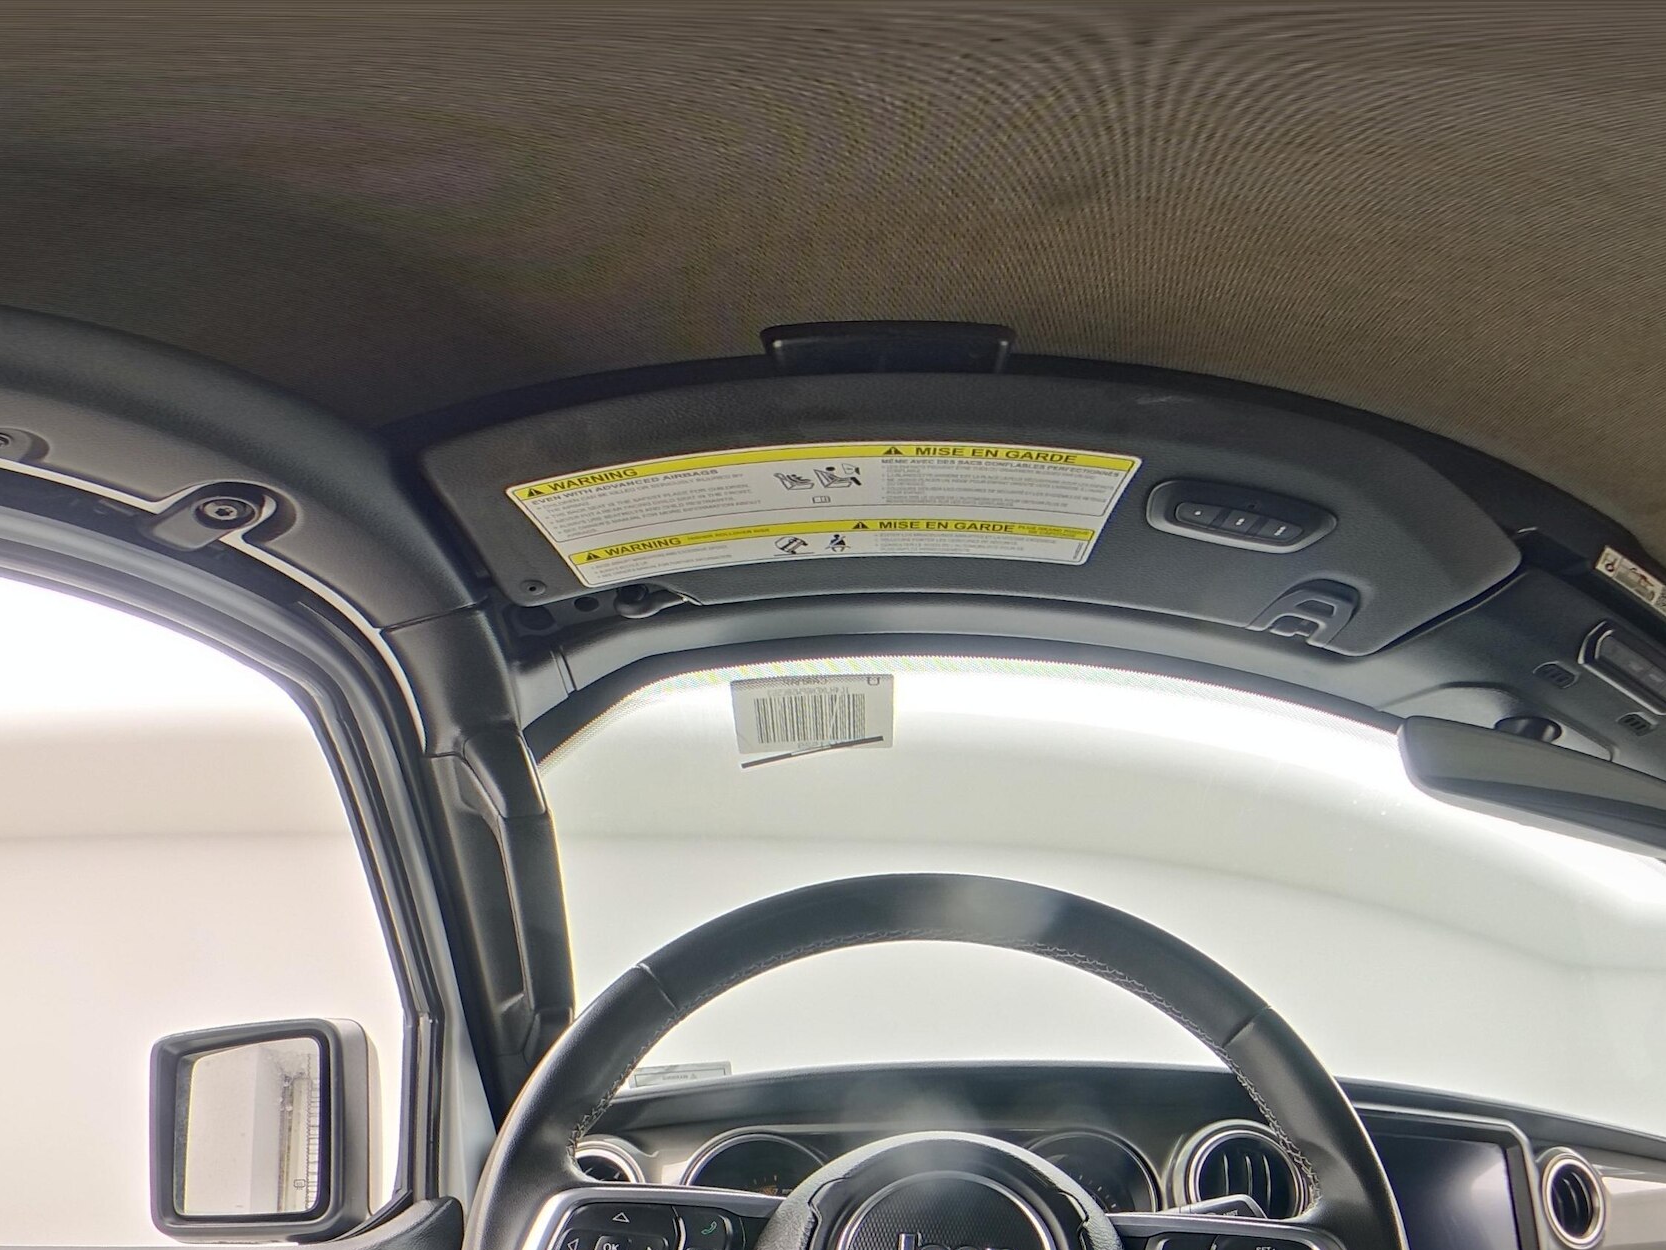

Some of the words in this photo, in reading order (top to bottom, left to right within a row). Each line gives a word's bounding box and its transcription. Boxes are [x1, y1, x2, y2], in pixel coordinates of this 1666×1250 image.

[915, 447, 964, 456] MISE
[971, 448, 998, 458] EN
[1005, 450, 1077, 463] GARDE
[532, 494, 561, 505] EVEN
[563, 488, 592, 498] WITH
[595, 476, 659, 491] ADVANCED
[663, 469, 717, 480] AIRBAGS
[548, 468, 638, 491] WARNING
[879, 521, 920, 530] MISE
[925, 521, 949, 530] EN
[954, 522, 1015, 533] GARDE
[605, 537, 682, 557] WARNING
